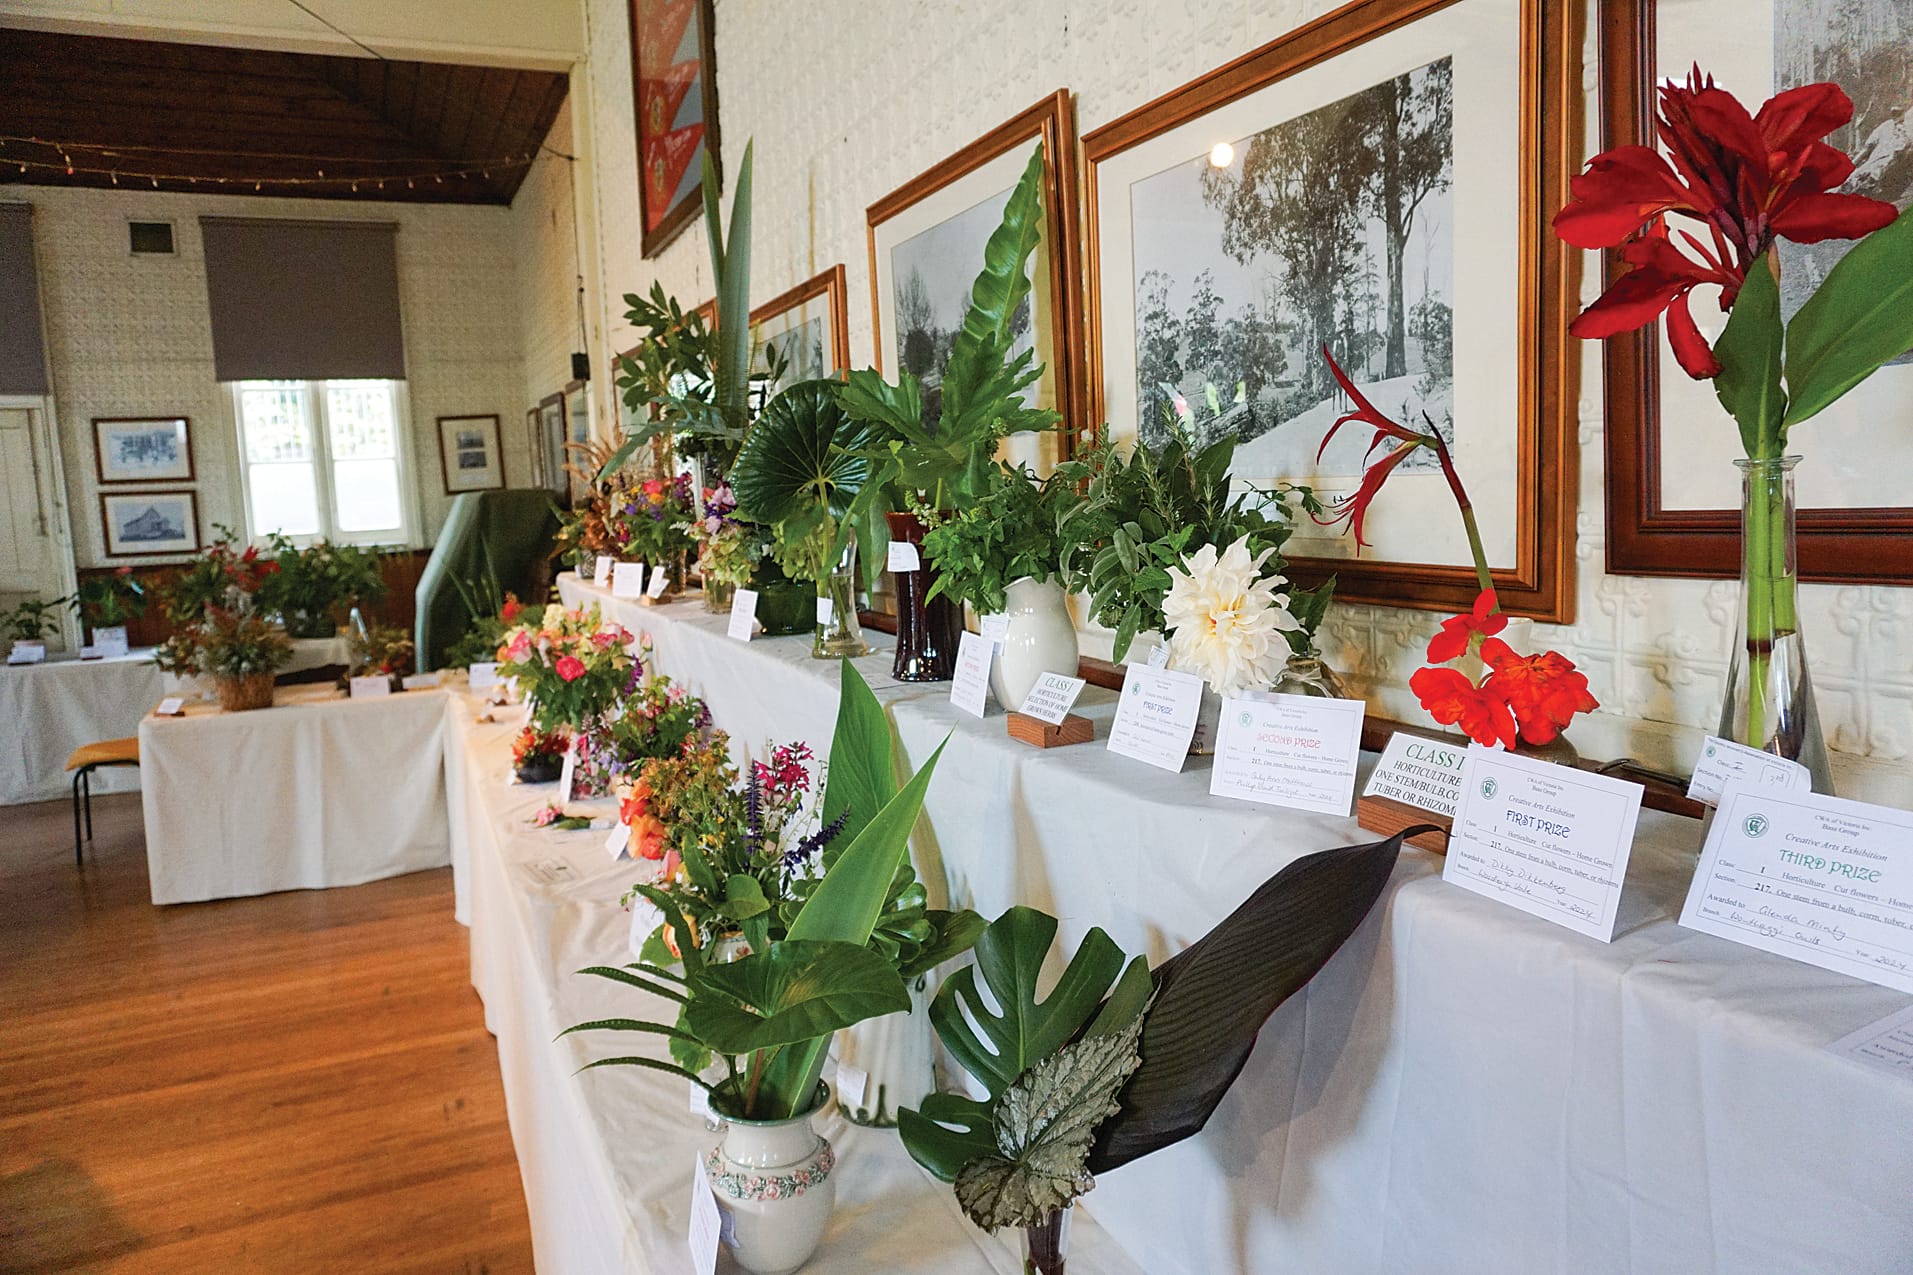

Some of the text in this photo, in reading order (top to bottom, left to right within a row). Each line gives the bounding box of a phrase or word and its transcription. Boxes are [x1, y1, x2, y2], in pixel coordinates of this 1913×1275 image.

[1045, 677, 1069, 691] CLASS
[1257, 732, 1321, 749] SECOND PRIZE
[1406, 743, 1466, 770] CLASS I
[1375, 769, 1459, 801] ONE STEM/BULB,CO
[1393, 760, 1463, 787] HORTICULTURE
[1373, 782, 1402, 799] TUBER
[1402, 791, 1416, 803] OR
[1508, 794, 1576, 819] Creative Arts Exhibition
[1506, 809, 1571, 839] FIRST PRIZE
[1838, 827, 1860, 837] Group
[1459, 850, 1480, 863] Awarded
[1507, 831, 1537, 845] Horticulture
[1541, 841, 1552, 849] Cut
[1551, 844, 1571, 856] flowers
[1576, 851, 1593, 863] Home
[1593, 857, 1613, 868] Grown
[1784, 832, 1888, 862] Creative Arts Exhibition
[1779, 848, 1882, 883] THIRD PRIZE
[1706, 893, 1738, 907] Awarded
[1714, 872, 1736, 884] Section
[1754, 882, 1772, 894] 217.
[1776, 889, 1792, 899] One
[1792, 893, 1810, 903] stem
[1811, 897, 1830, 908] from
[1782, 872, 1827, 889] Horticulture
[1833, 884, 1849, 894] Cut
[1849, 888, 1879, 902] flowers
[1888, 897, 1913, 910] Home
[1570, 904, 1595, 918] 2024
[1874, 955, 1906, 970] 2024
